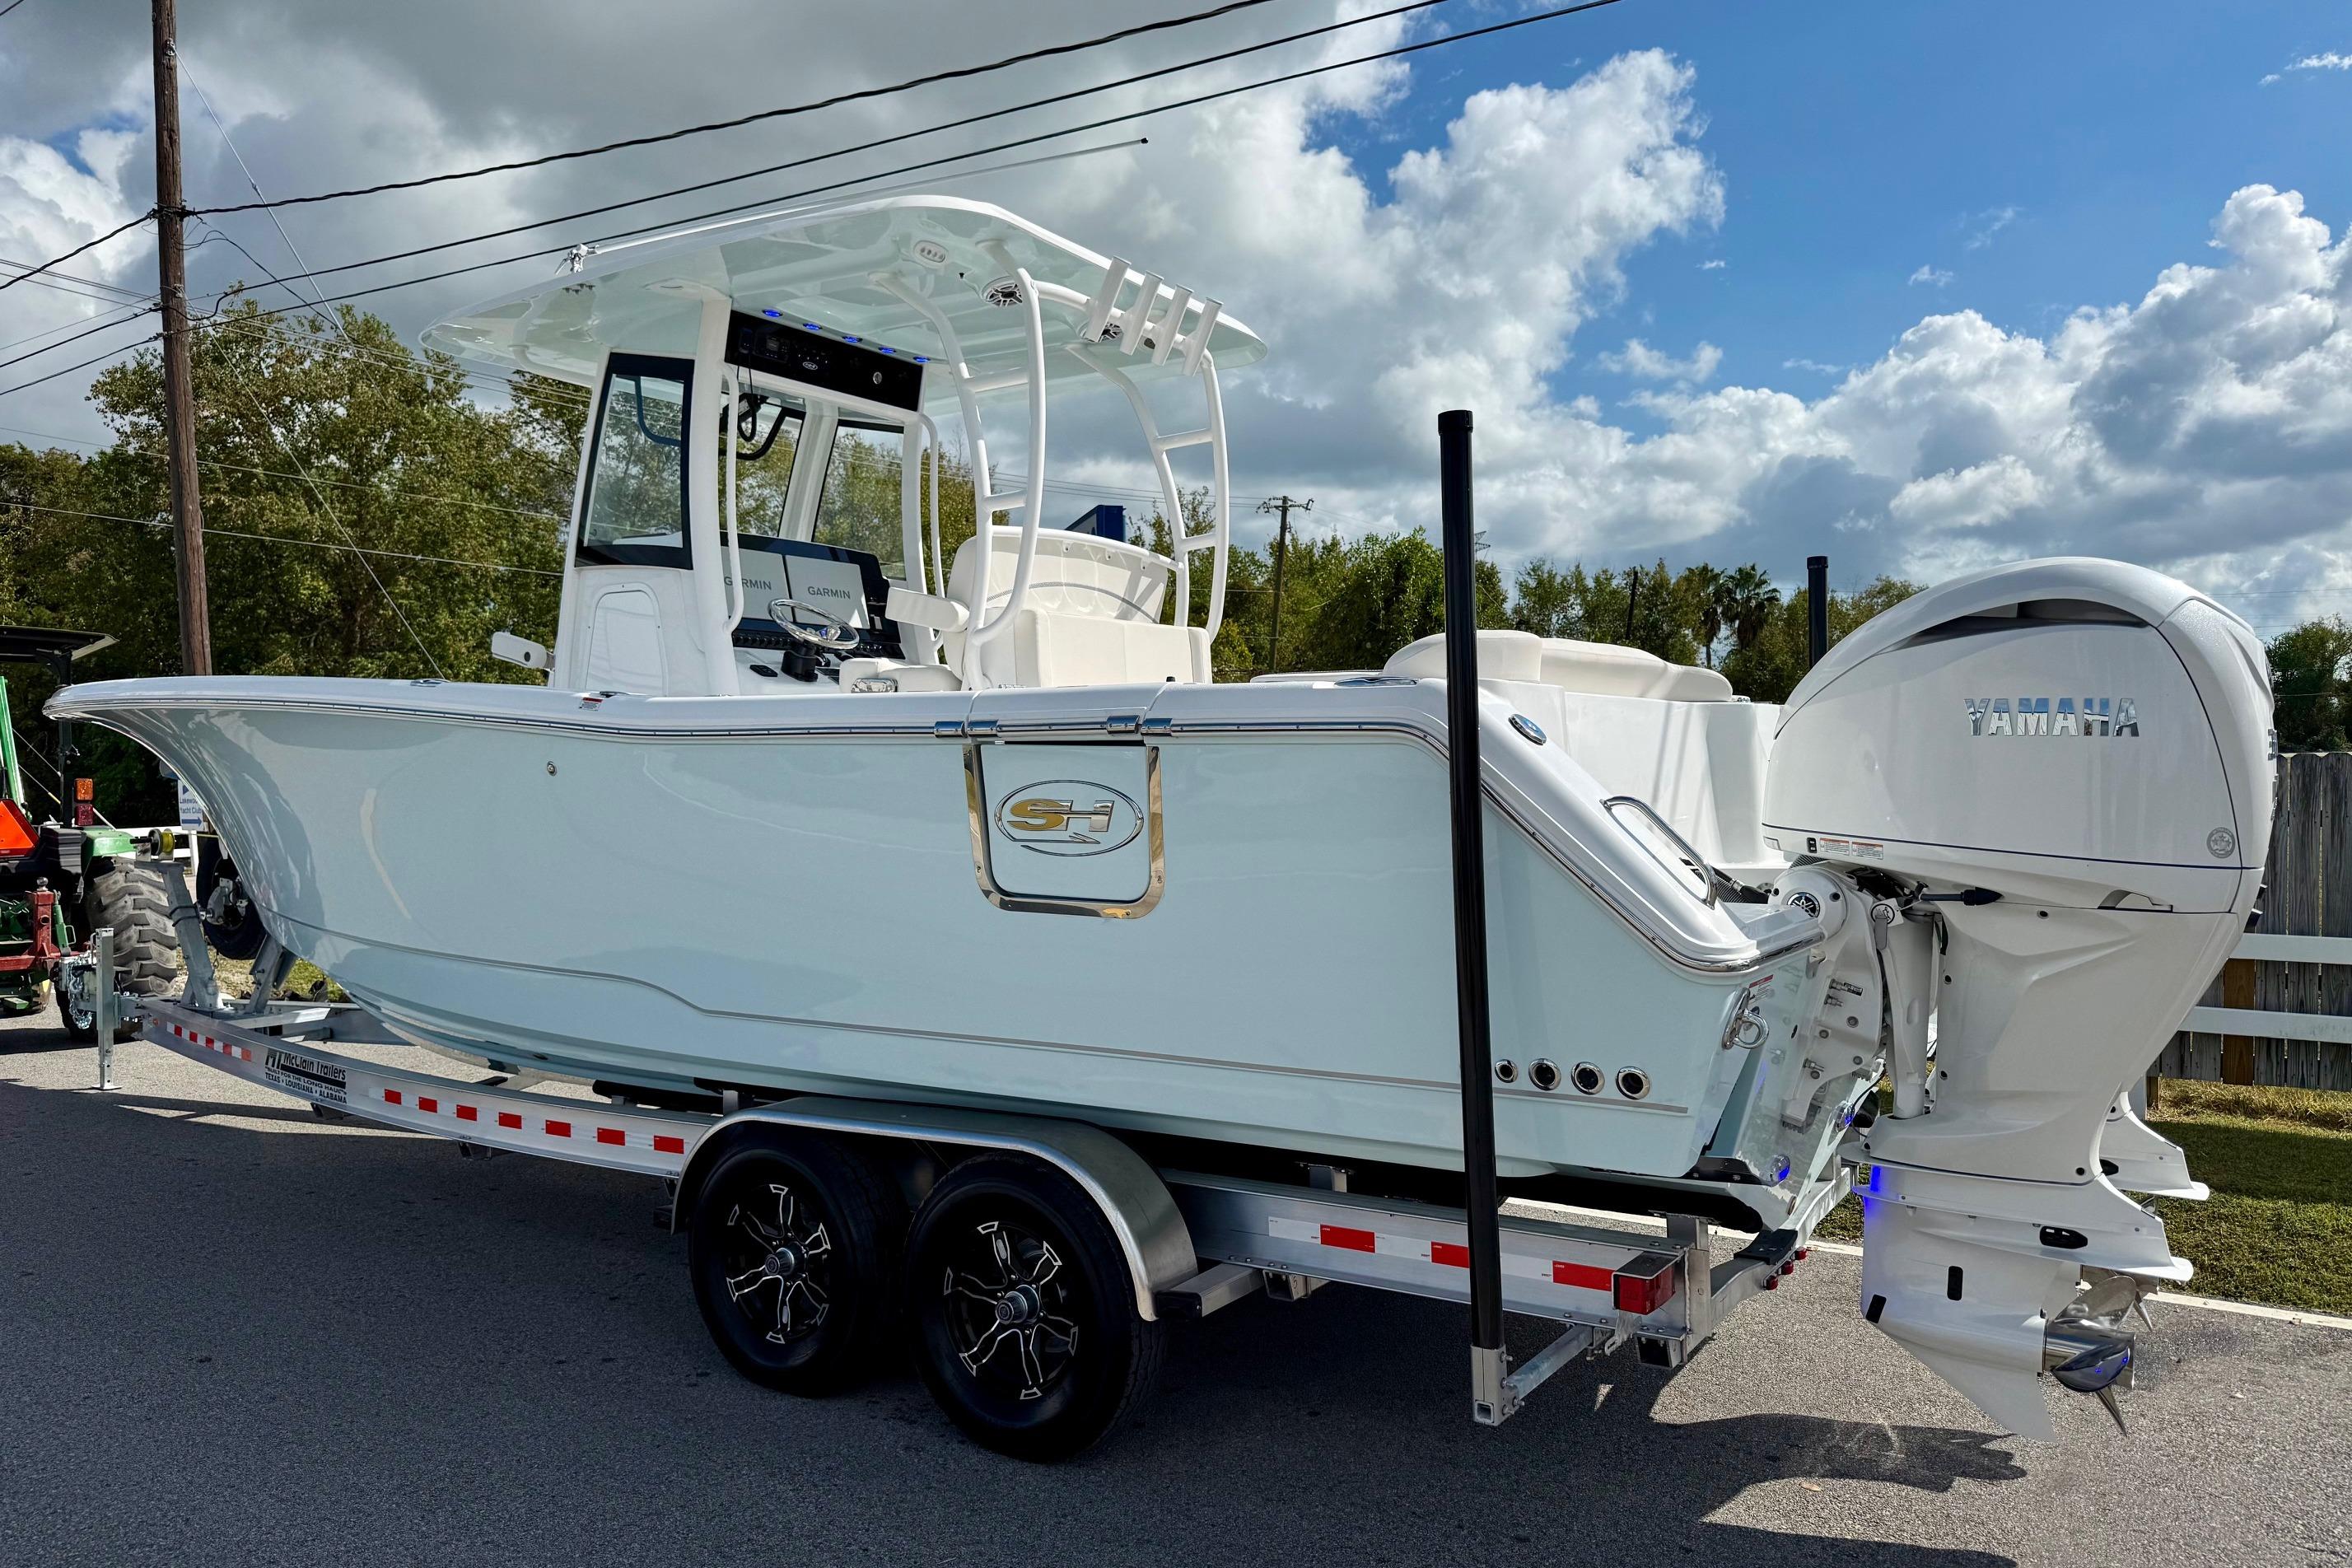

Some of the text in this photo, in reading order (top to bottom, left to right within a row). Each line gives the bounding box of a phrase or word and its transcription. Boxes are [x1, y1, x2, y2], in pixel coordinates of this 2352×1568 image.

[724, 576, 772, 590] GRMIN
[808, 586, 851, 600] GARMIN
[1963, 698, 2140, 736] YAMAHA
[1007, 798, 1114, 832] SH
[283, 1052, 347, 1080] McClain Trailers
[265, 1071, 347, 1104] TEXAS LOUISIANA ALABAMA
[303, 1078, 323, 1089] LONG
